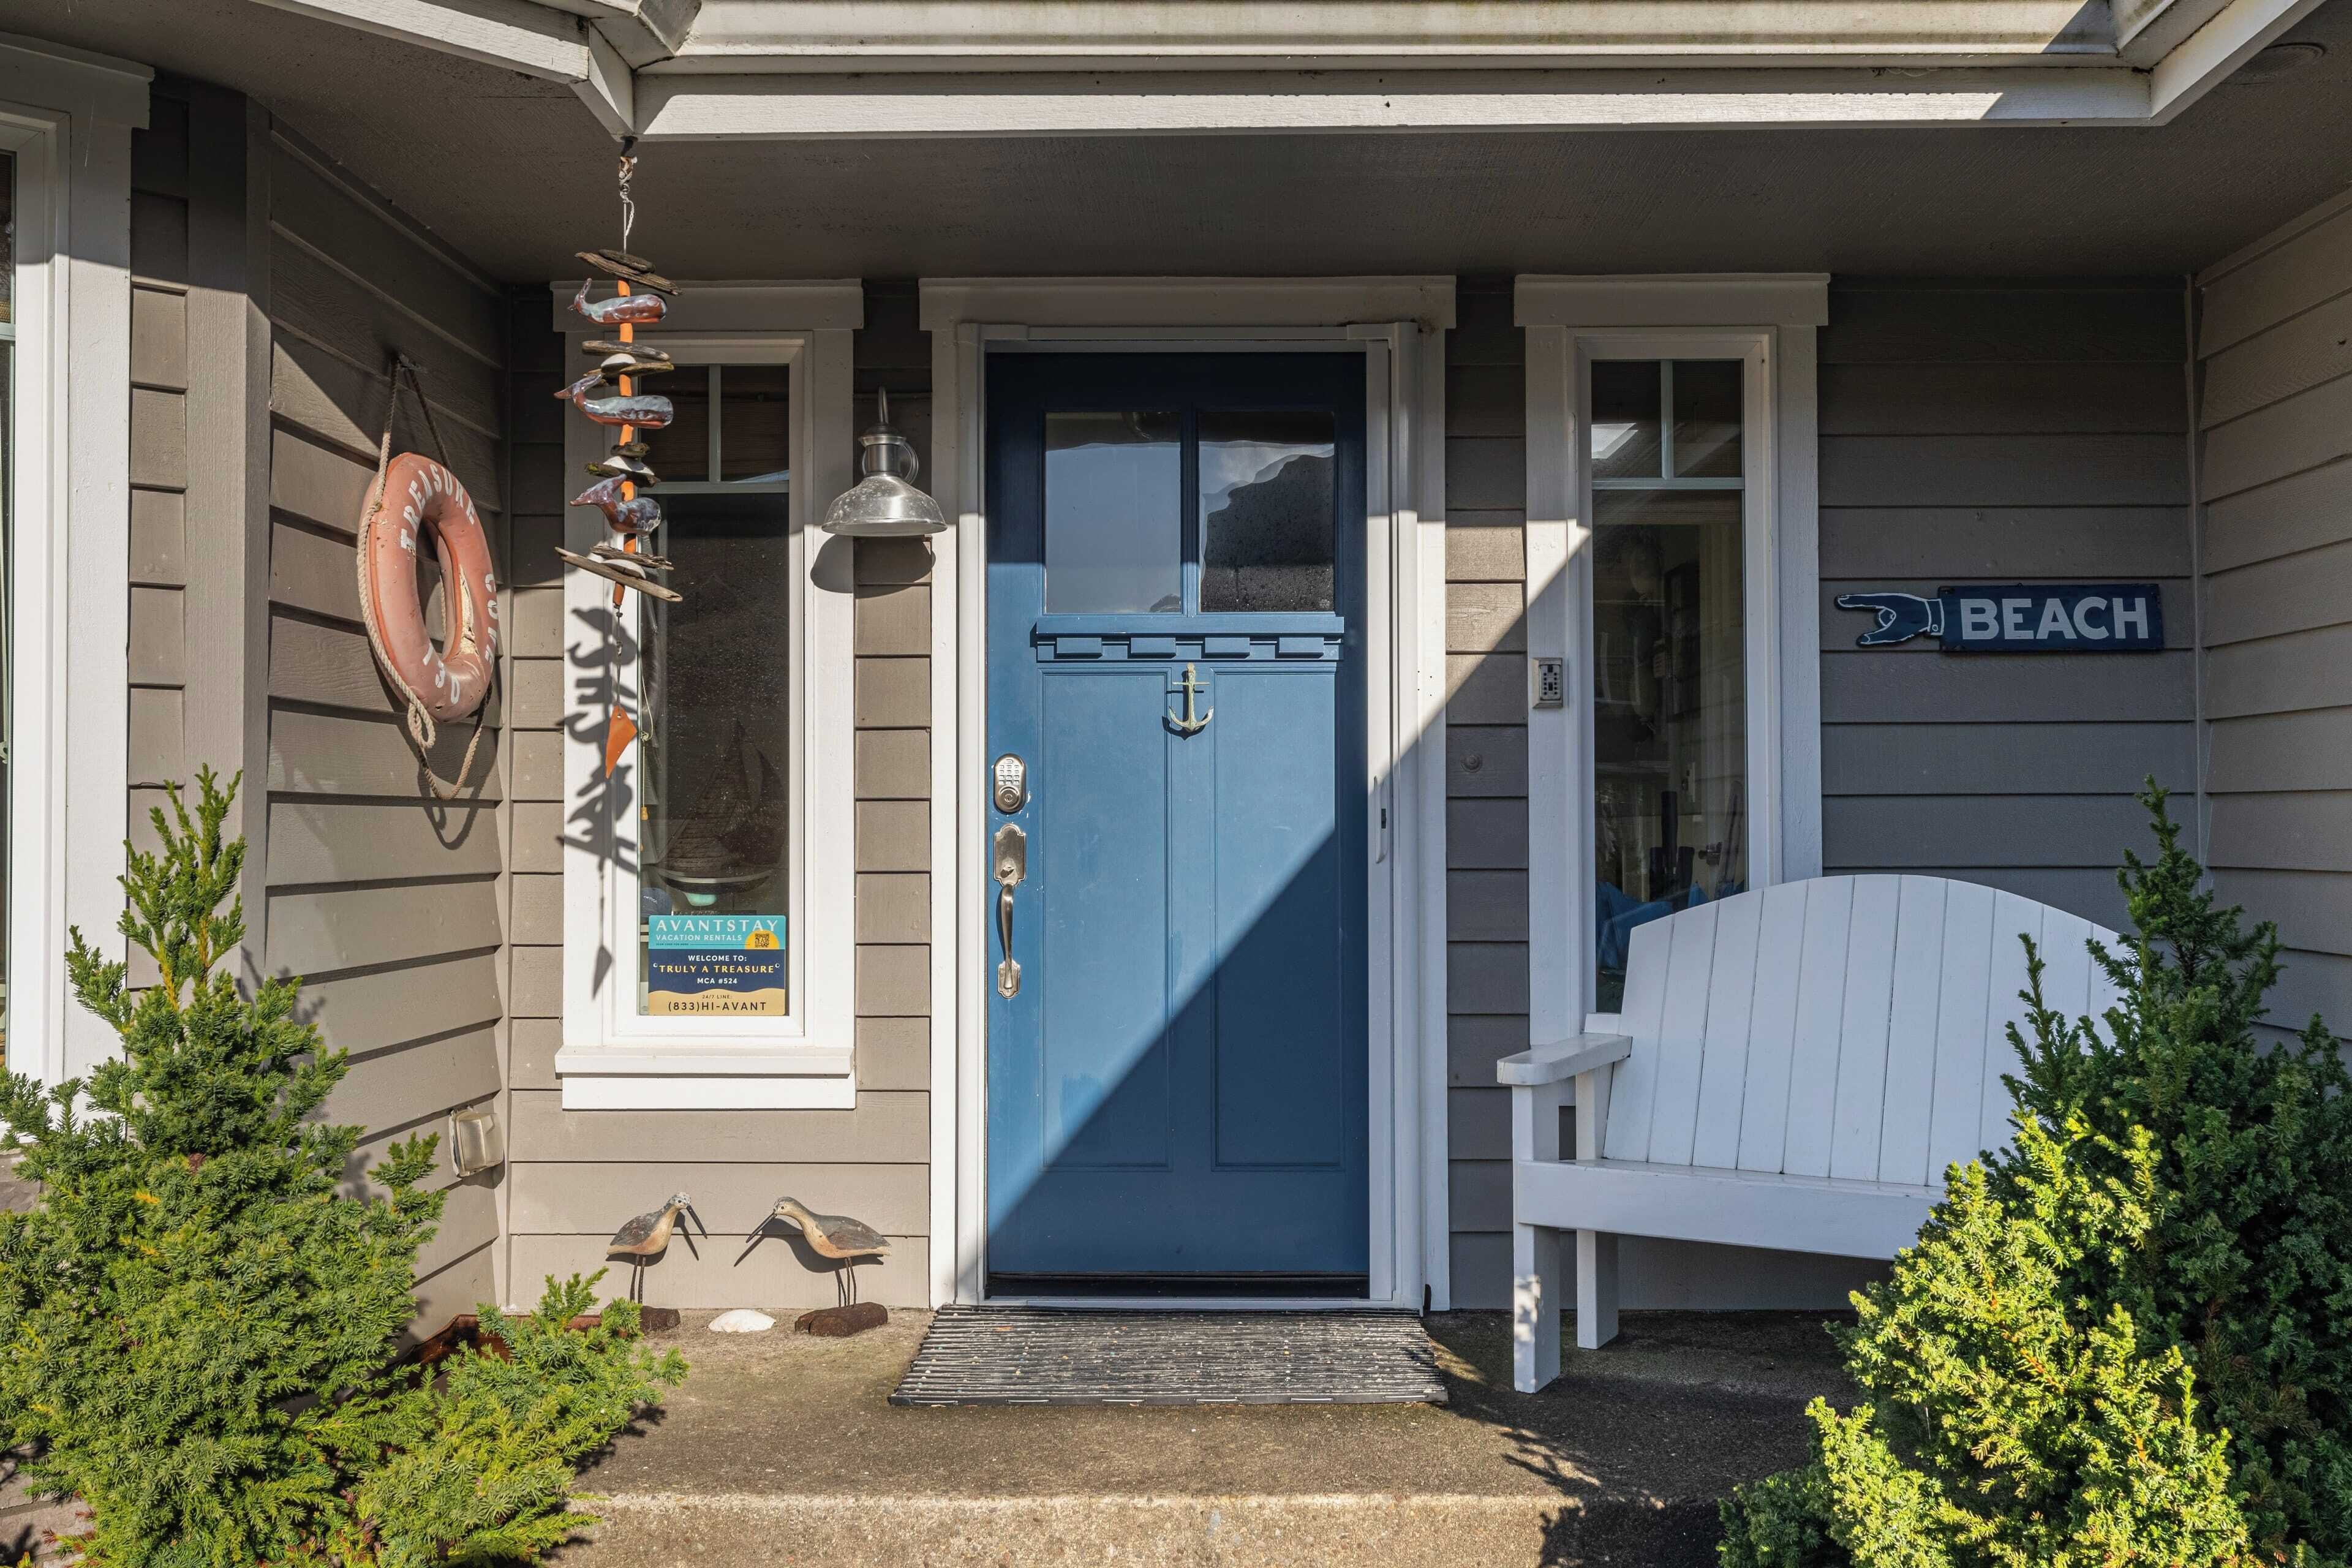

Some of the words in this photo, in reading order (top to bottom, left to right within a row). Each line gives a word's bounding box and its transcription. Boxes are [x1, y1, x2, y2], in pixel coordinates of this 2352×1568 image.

[401, 464, 475, 550] TREASURE
[1961, 597, 2148, 639] BEACH
[656, 920, 778, 932] AVANTSTAY
[668, 1002, 767, 1012] (833)HI-AVANT
